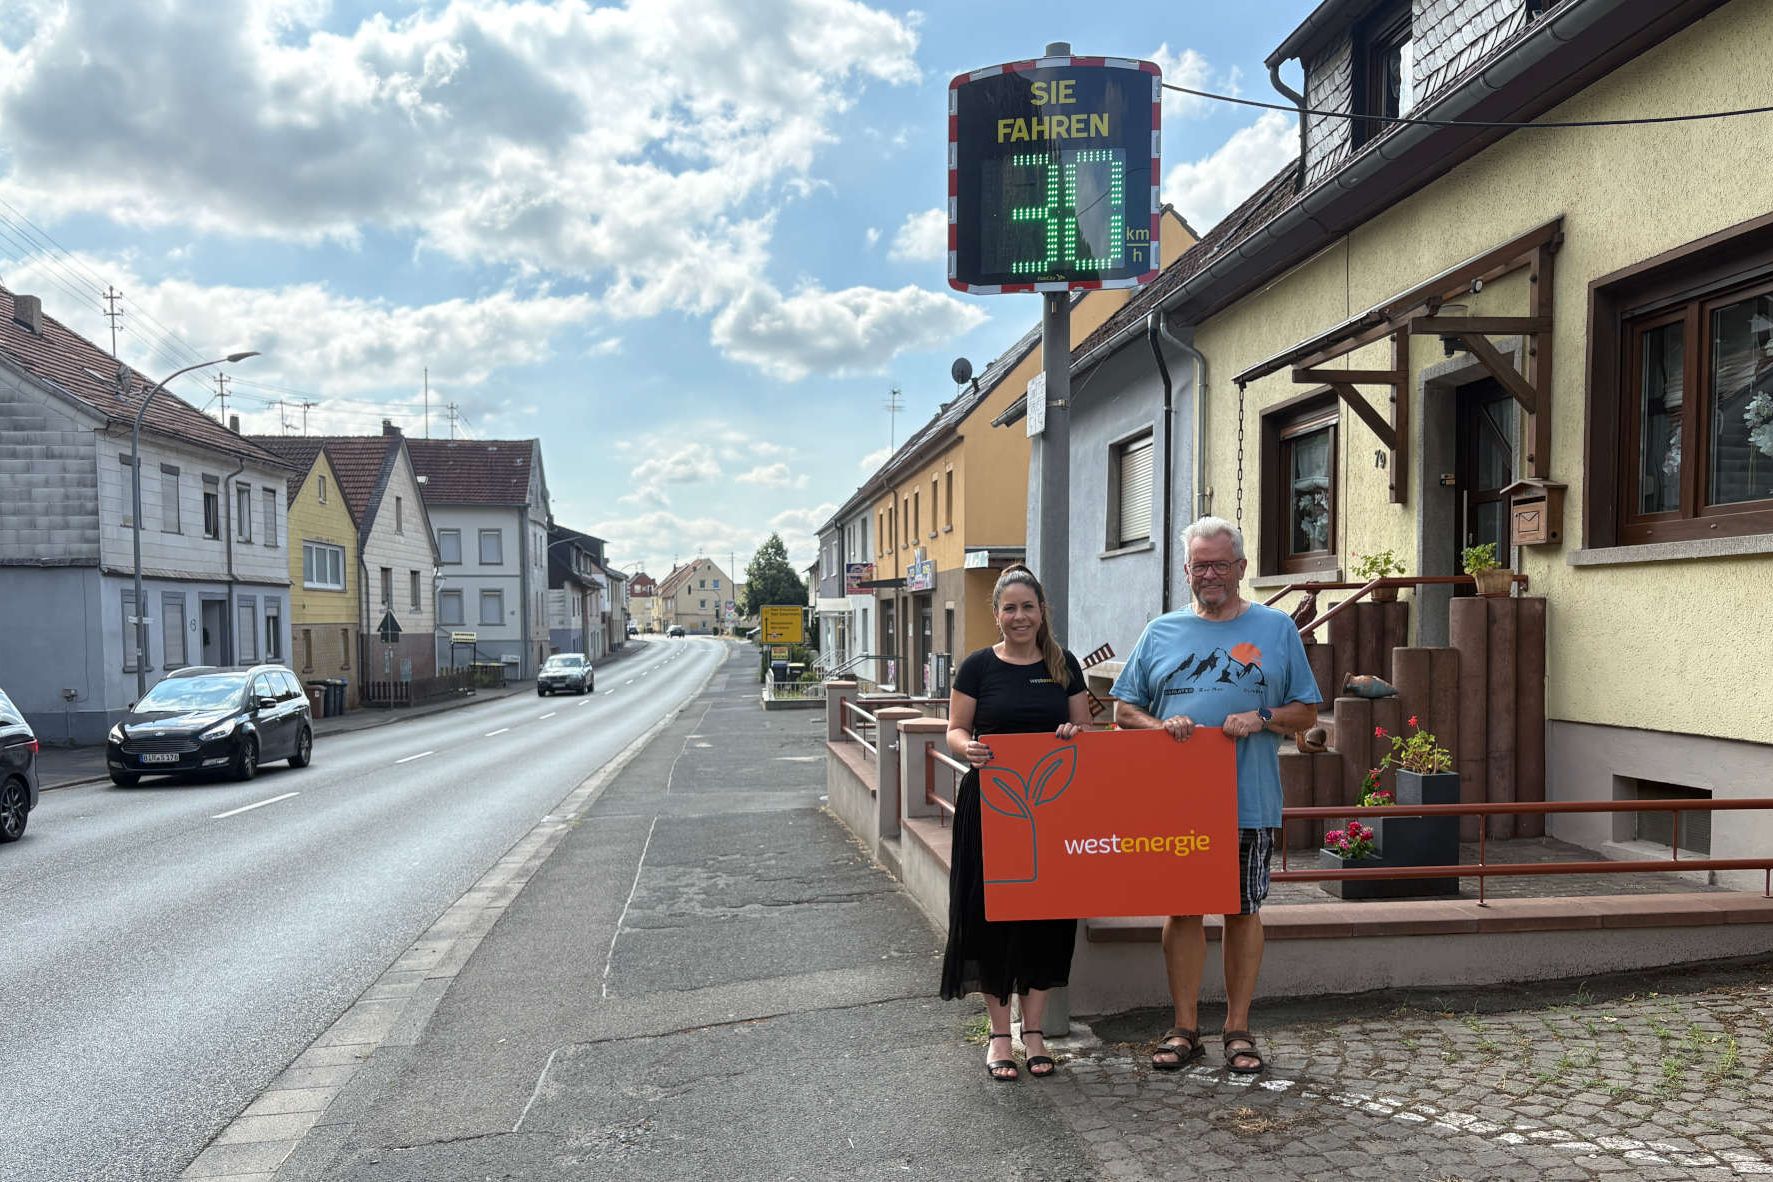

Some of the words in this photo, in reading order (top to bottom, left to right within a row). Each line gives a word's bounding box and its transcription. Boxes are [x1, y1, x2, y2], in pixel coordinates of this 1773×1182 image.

[1030, 79, 1077, 106] SIE
[997, 112, 1110, 144] FAHREN
[1011, 149, 1123, 274] 30
[1126, 226, 1150, 241] km
[1132, 248, 1143, 263] h
[1064, 828, 1211, 857] westenergie
